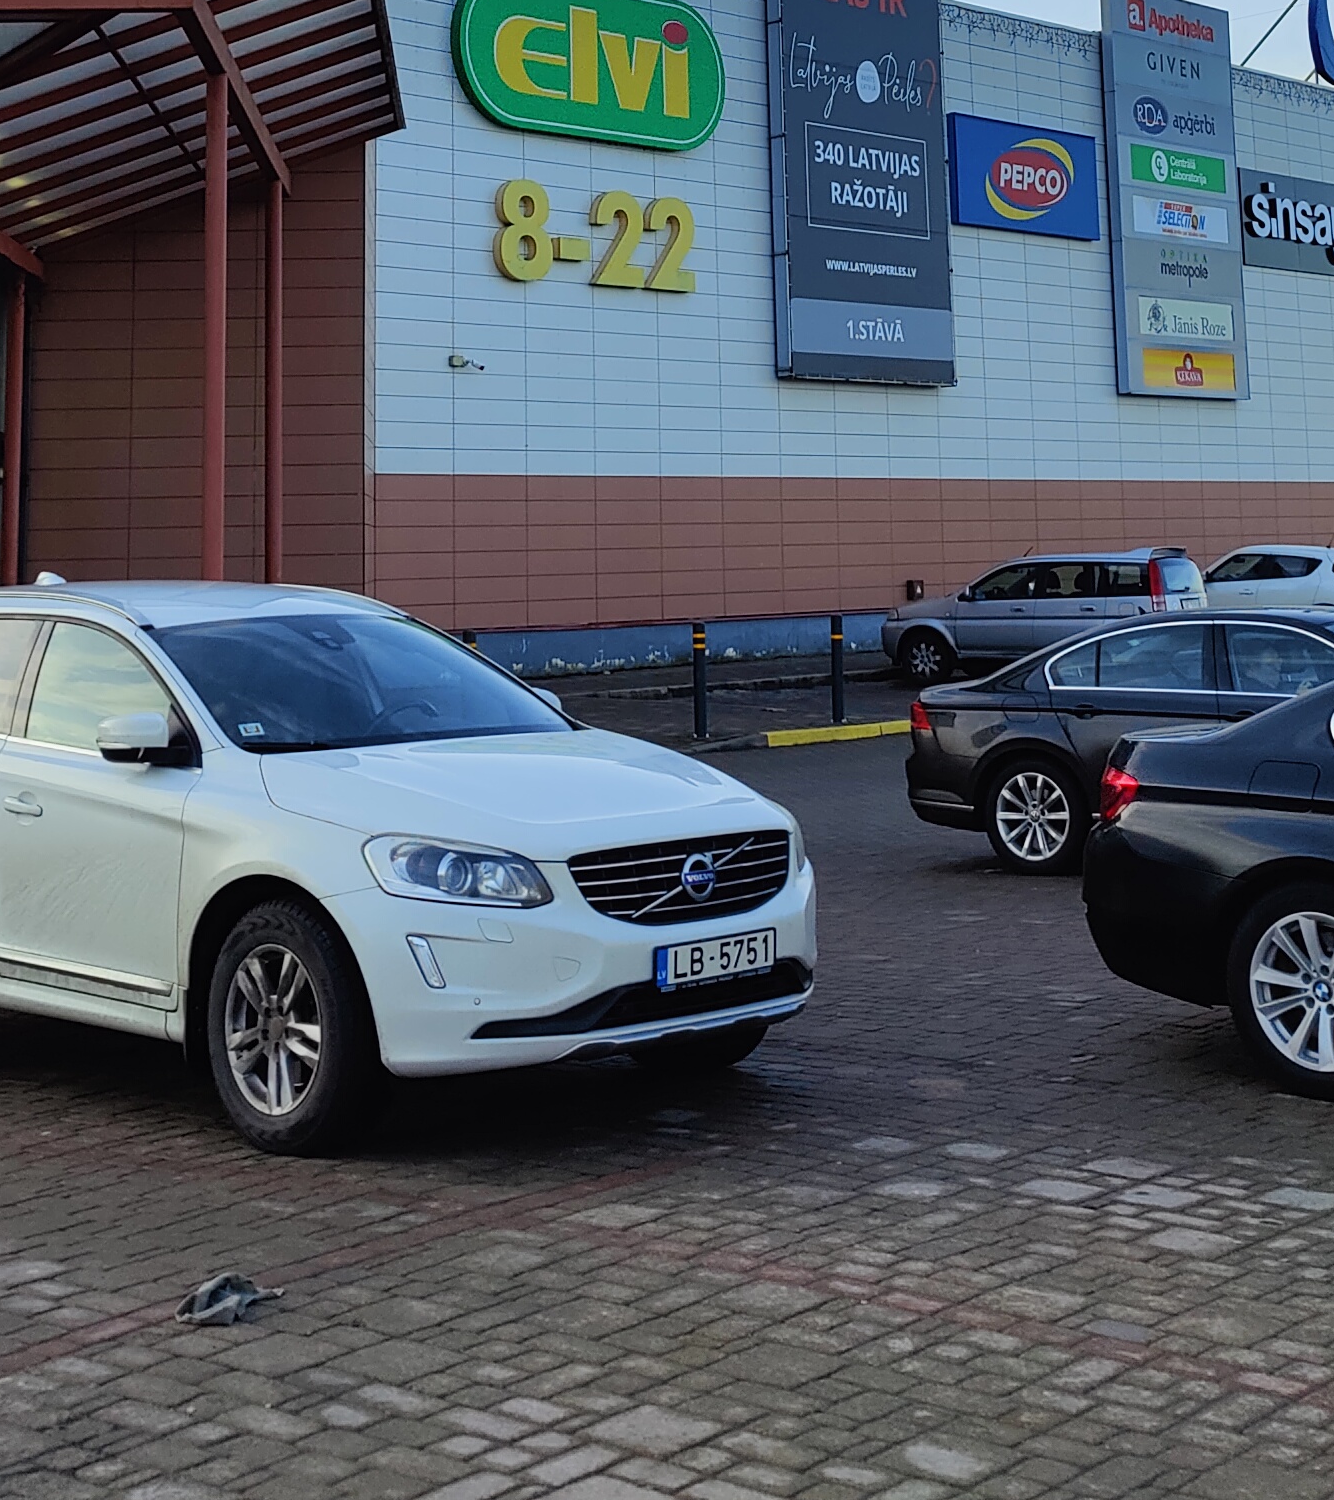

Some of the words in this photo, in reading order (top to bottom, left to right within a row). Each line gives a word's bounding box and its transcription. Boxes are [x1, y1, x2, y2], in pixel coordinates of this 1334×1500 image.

[1148, 8, 1214, 43] Apotheka
[789, 32, 854, 119] Latvijas
[1147, 51, 1201, 80] GIVEN
[1136, 103, 1166, 127] RDA
[1172, 111, 1216, 137] apģērbi
[814, 140, 844, 165] 340
[848, 145, 920, 179] LATVIJAS
[999, 161, 1062, 196] PEPCO
[830, 179, 908, 217] RAŽOTĀJI
[493, 178, 697, 293] 8-22
[825, 259, 917, 278] WWW.LATVIJASPERLES.LV
[1160, 261, 1208, 288] metropole
[846, 318, 905, 343] 1.STĀVĀ
[1171, 314, 1199, 335] Jānis
[1200, 317, 1227, 337] Roze
[686, 872, 714, 883] VOLVO
[657, 969, 667, 980] LV
[674, 934, 769, 979] LB-5751
